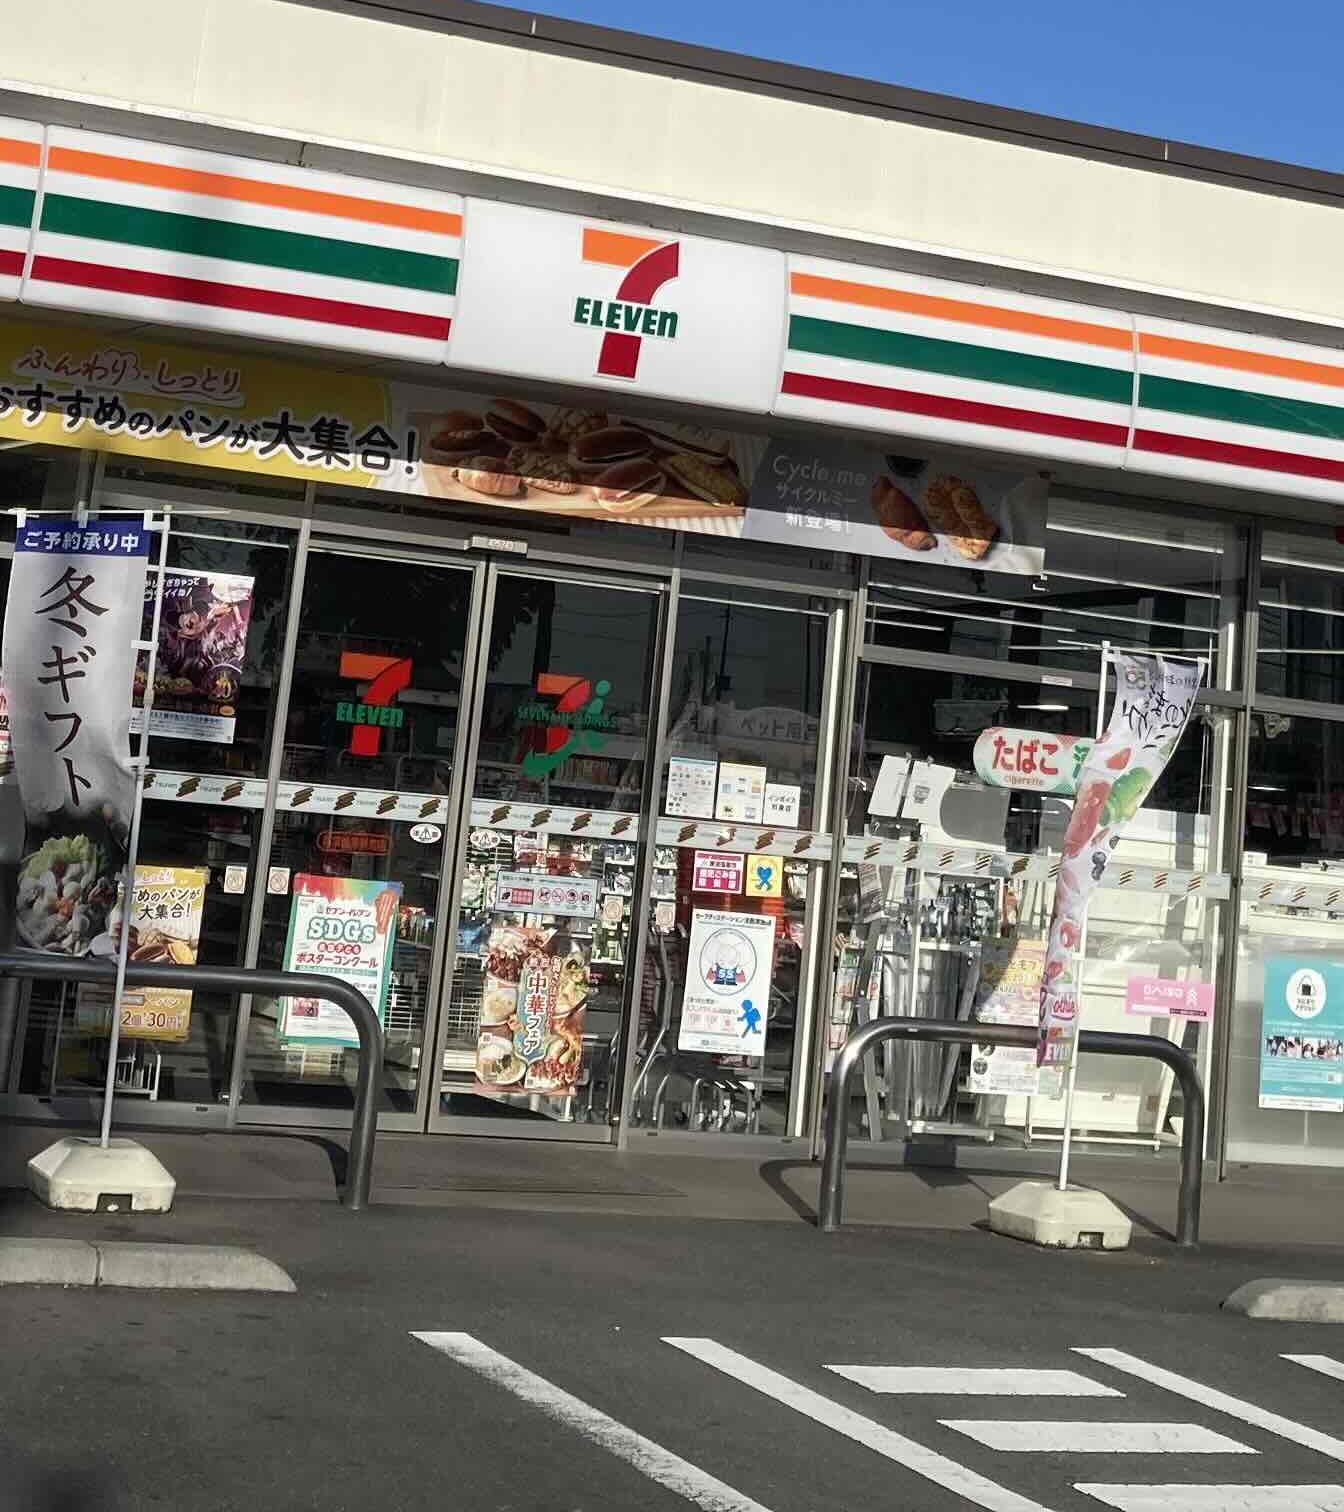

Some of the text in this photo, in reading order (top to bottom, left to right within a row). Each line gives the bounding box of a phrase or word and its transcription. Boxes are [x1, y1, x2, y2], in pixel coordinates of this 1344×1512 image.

[776, 481, 858, 505] サイクルミー
[24, 530, 140, 553] ご予約承り中
[35, 565, 110, 807] 冬ギフト
[991, 735, 1058, 775] たばこ
[138, 903, 192, 921] 大集合!
[308, 917, 376, 944] SDGs
[296, 952, 379, 969] ポスターコンクール
[523, 970, 548, 1055] 中華フェア
